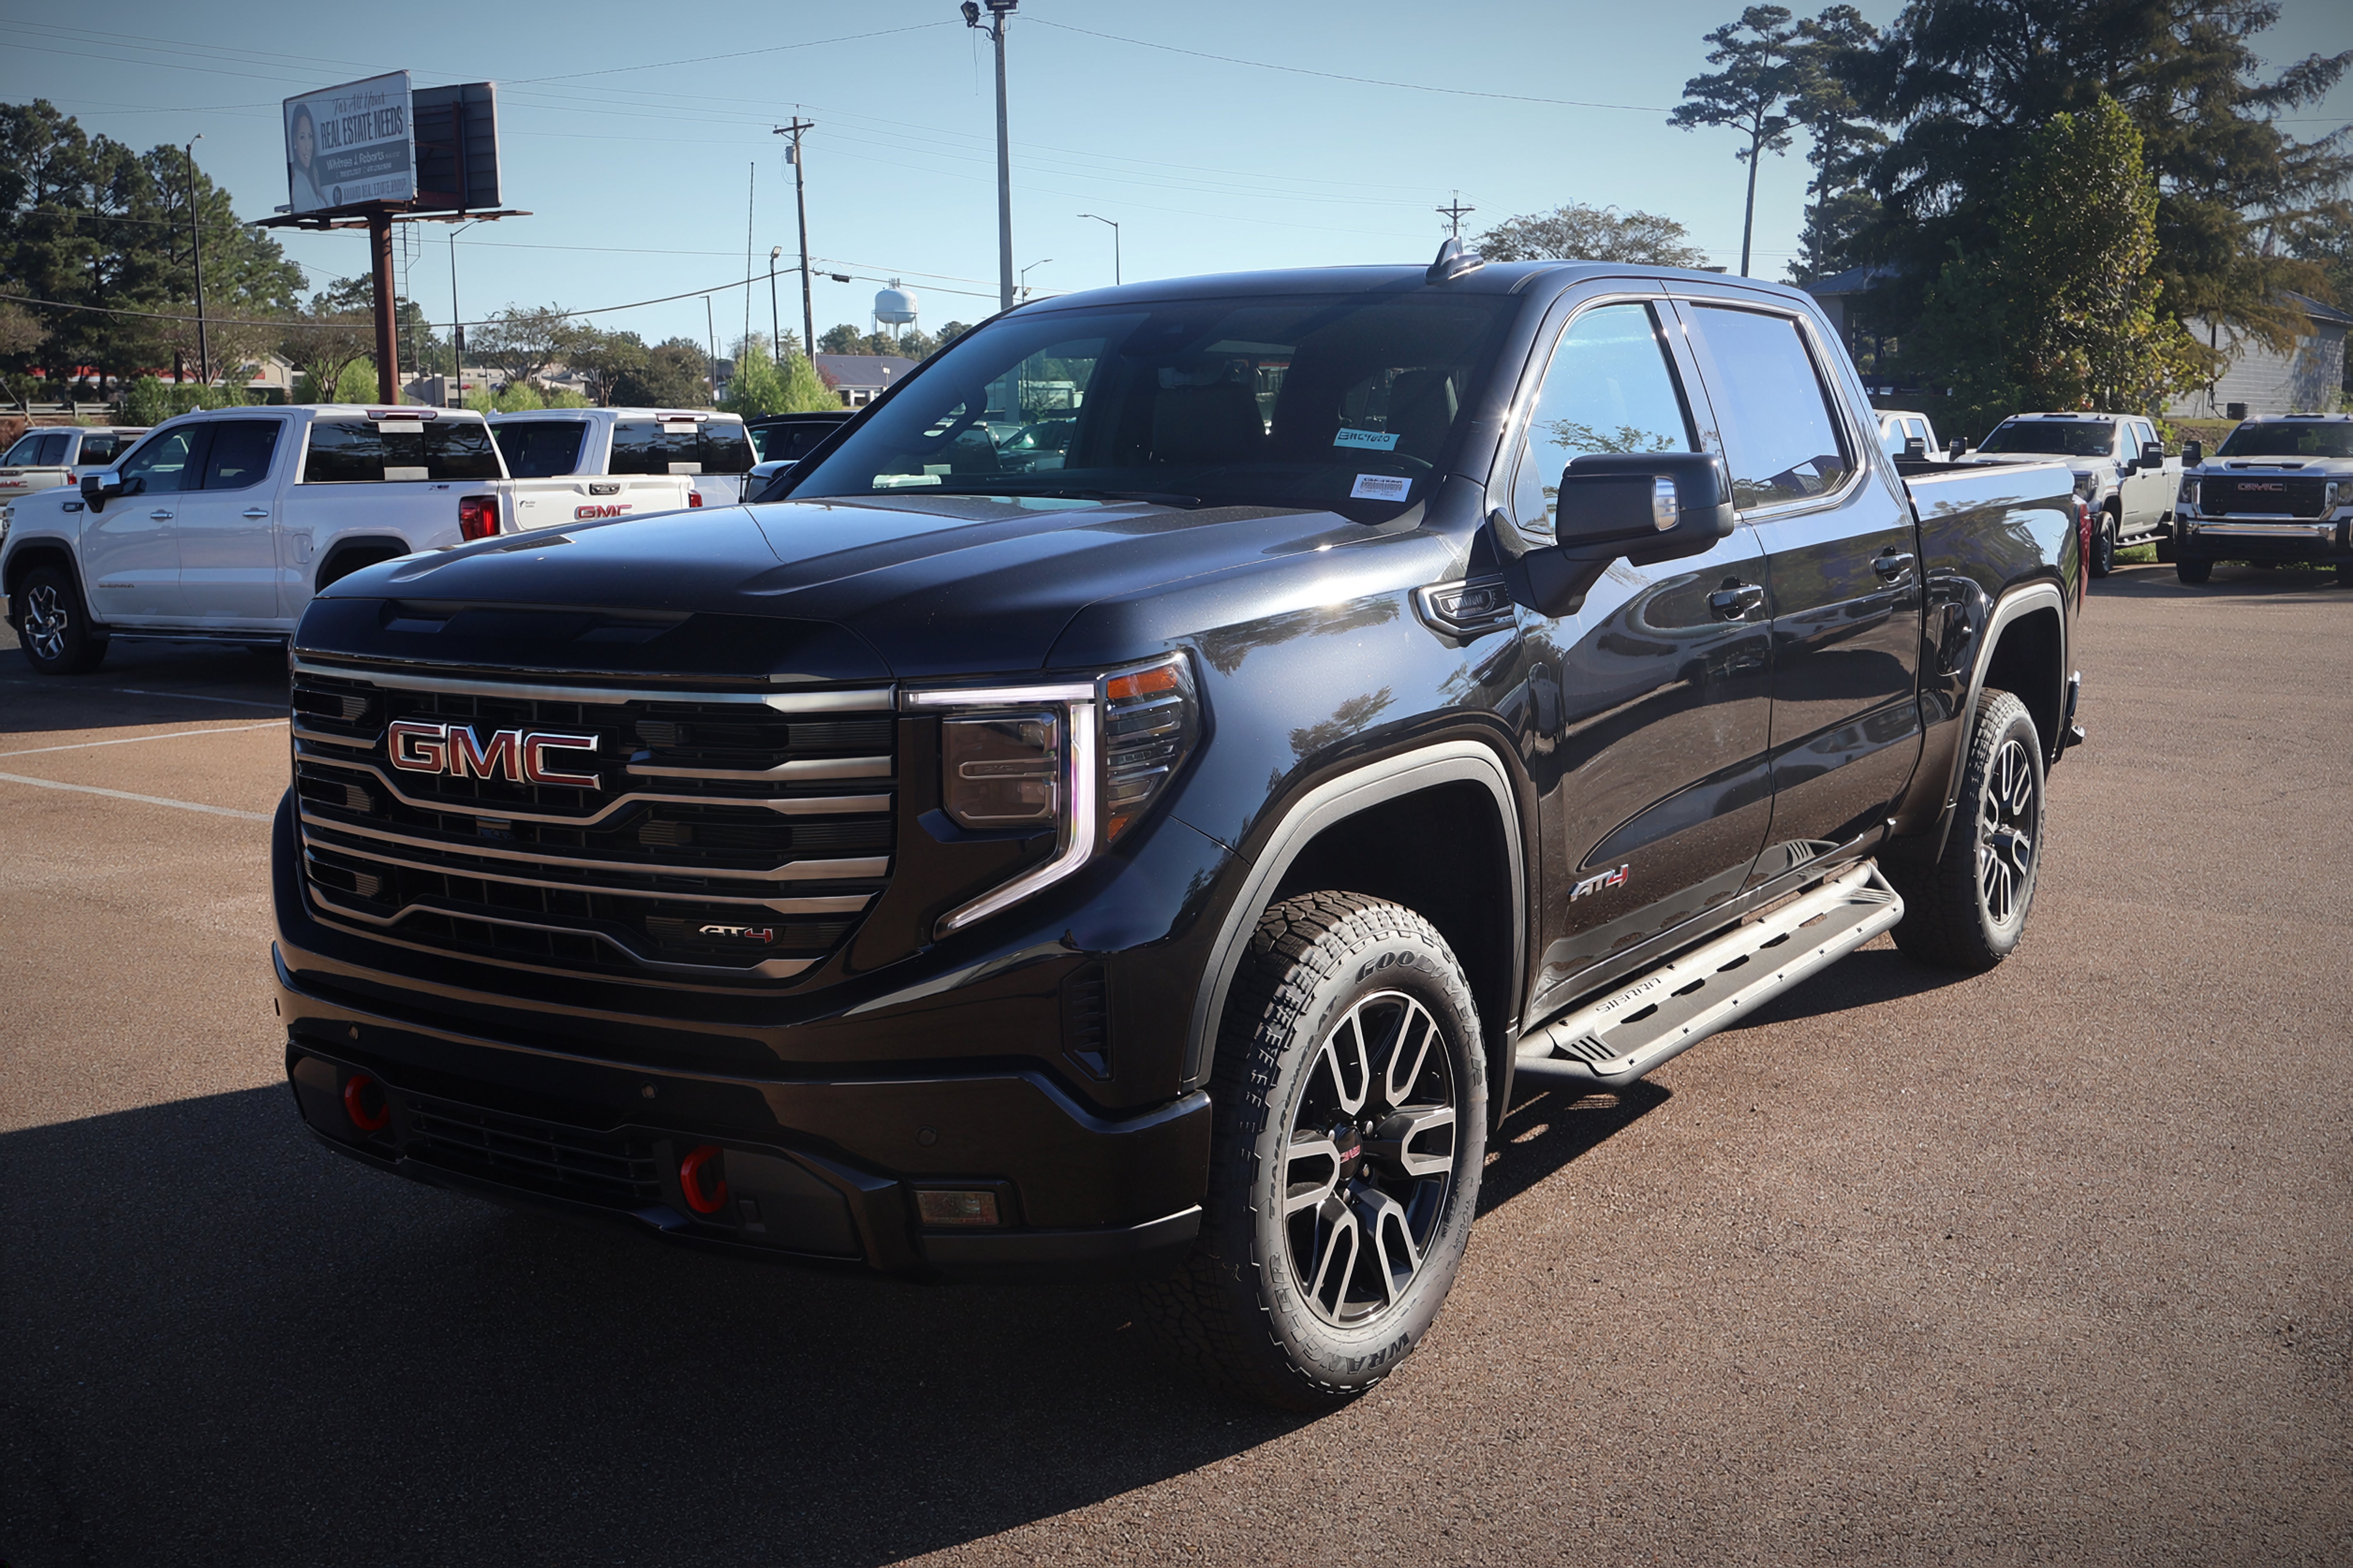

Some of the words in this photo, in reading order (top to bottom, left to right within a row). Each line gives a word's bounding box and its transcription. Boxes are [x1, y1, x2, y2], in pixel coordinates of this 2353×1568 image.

[320, 119, 342, 150] REAL
[342, 112, 373, 145] ESTATE
[374, 105, 403, 139] NEEDS
[2237, 483, 2283, 491] GMC
[575, 504, 632, 520] GMC
[389, 721, 601, 790] GMC
[1568, 863, 1628, 902] AT4
[699, 925, 773, 943] AT4
[1596, 977, 1661, 1013] SIERRA
[1355, 950, 1483, 1086] GOODYEAR
[1268, 1244, 1410, 1375] WRANGLER
